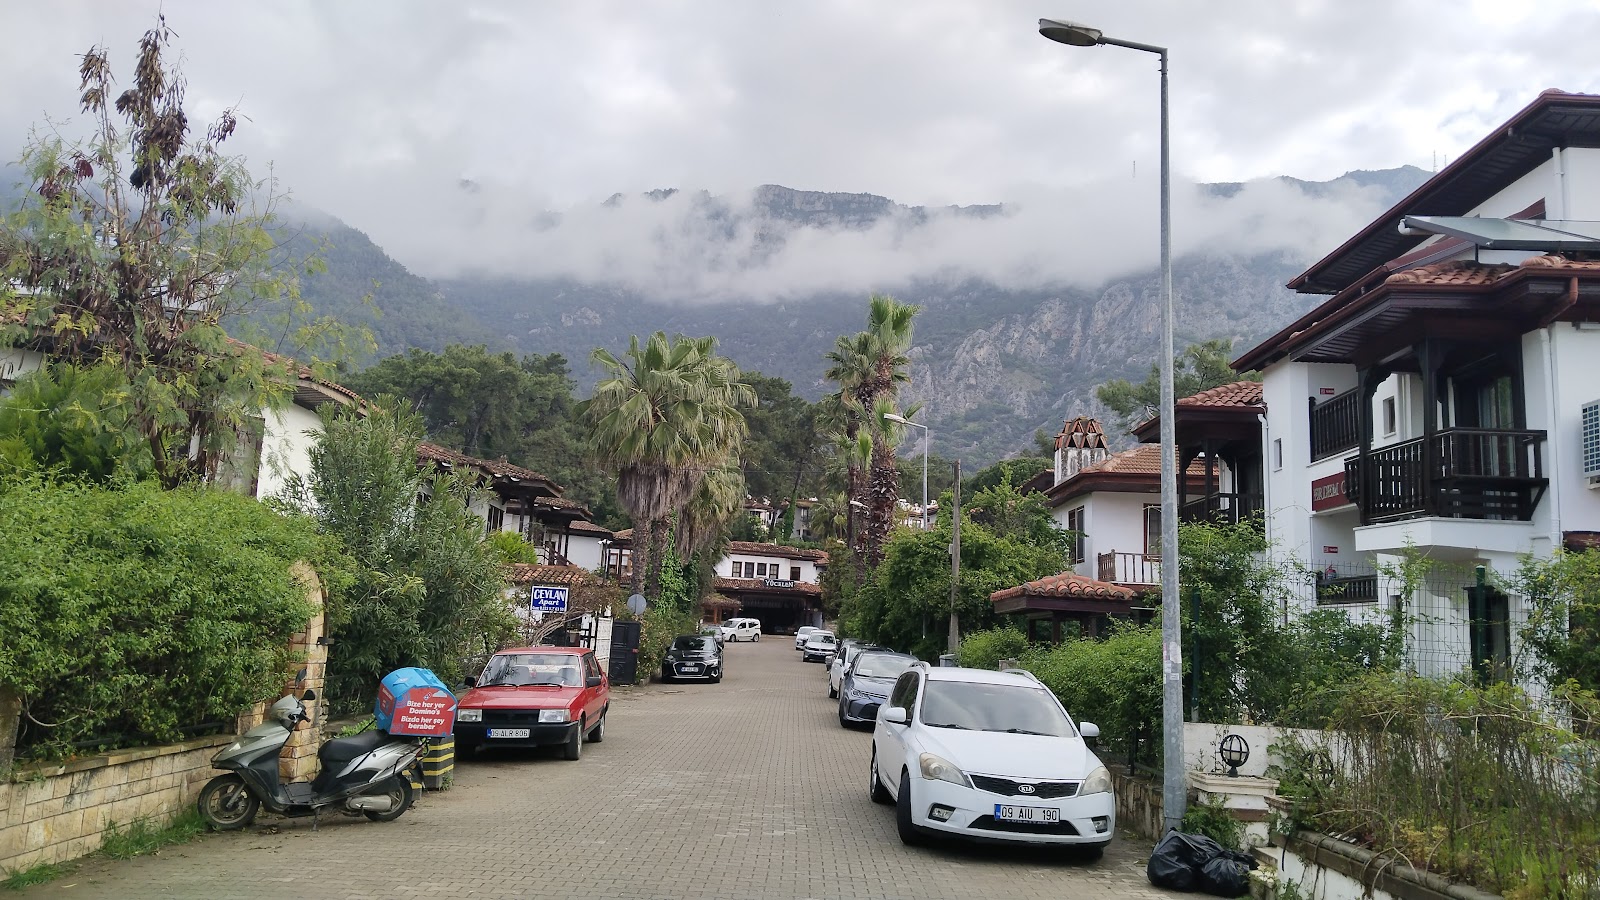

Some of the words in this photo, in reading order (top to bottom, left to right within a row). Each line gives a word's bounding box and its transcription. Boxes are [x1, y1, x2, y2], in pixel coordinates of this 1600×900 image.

[534, 589, 565, 601] CEYLAN
[409, 707, 440, 715] Domino's
[401, 715, 420, 723] Bizde
[1001, 806, 1013, 818] 09
[1018, 808, 1033, 820] AIU
[1042, 809, 1057, 821] 190
